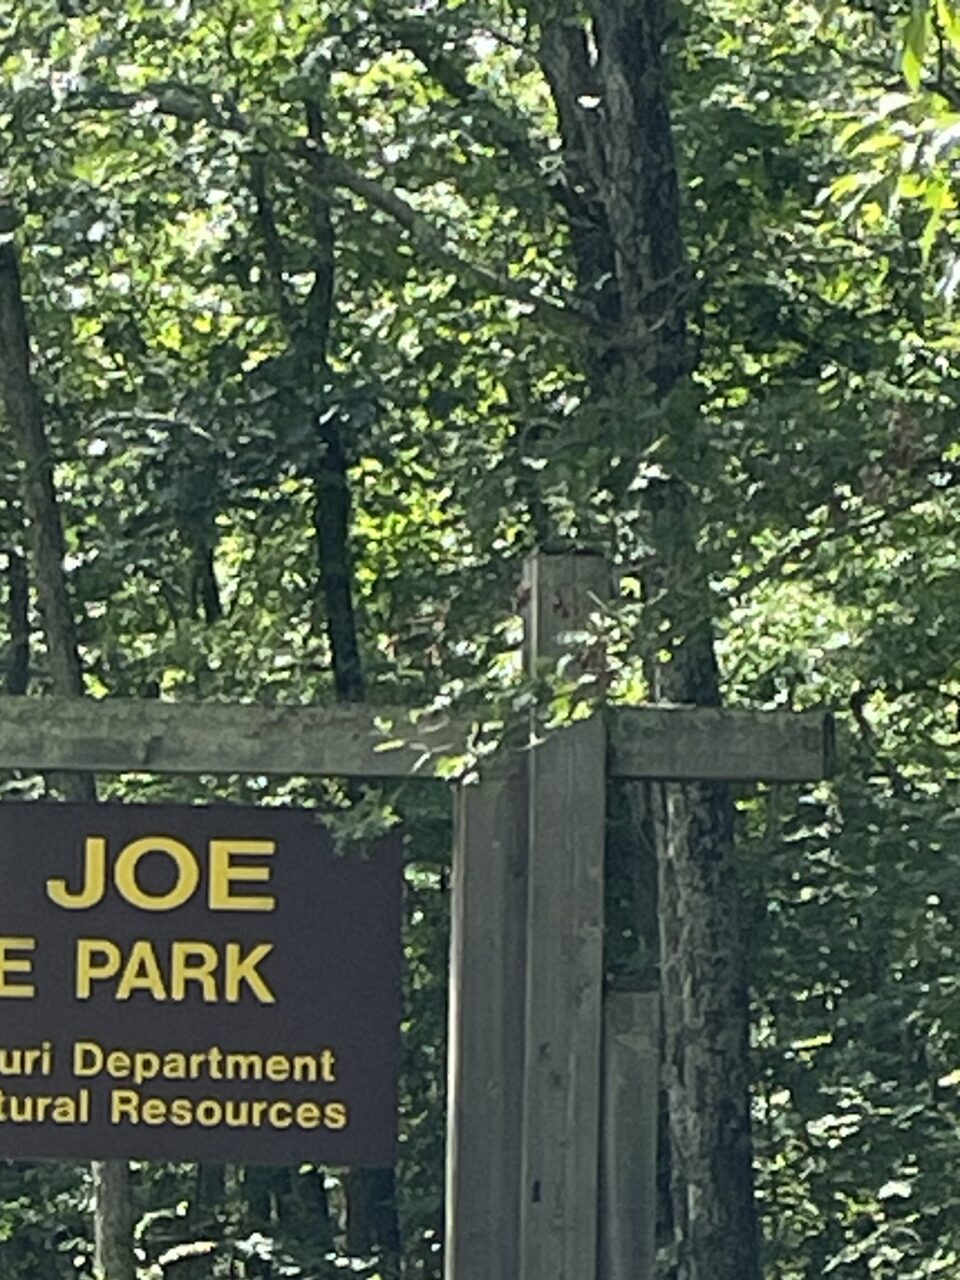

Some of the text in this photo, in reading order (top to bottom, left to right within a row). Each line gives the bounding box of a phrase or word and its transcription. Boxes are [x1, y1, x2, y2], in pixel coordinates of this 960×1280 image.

[46, 837, 276, 911] JOE
[76, 939, 275, 1003] PARK
[73, 1042, 335, 1085] Department
[111, 1089, 346, 1129] Resources
